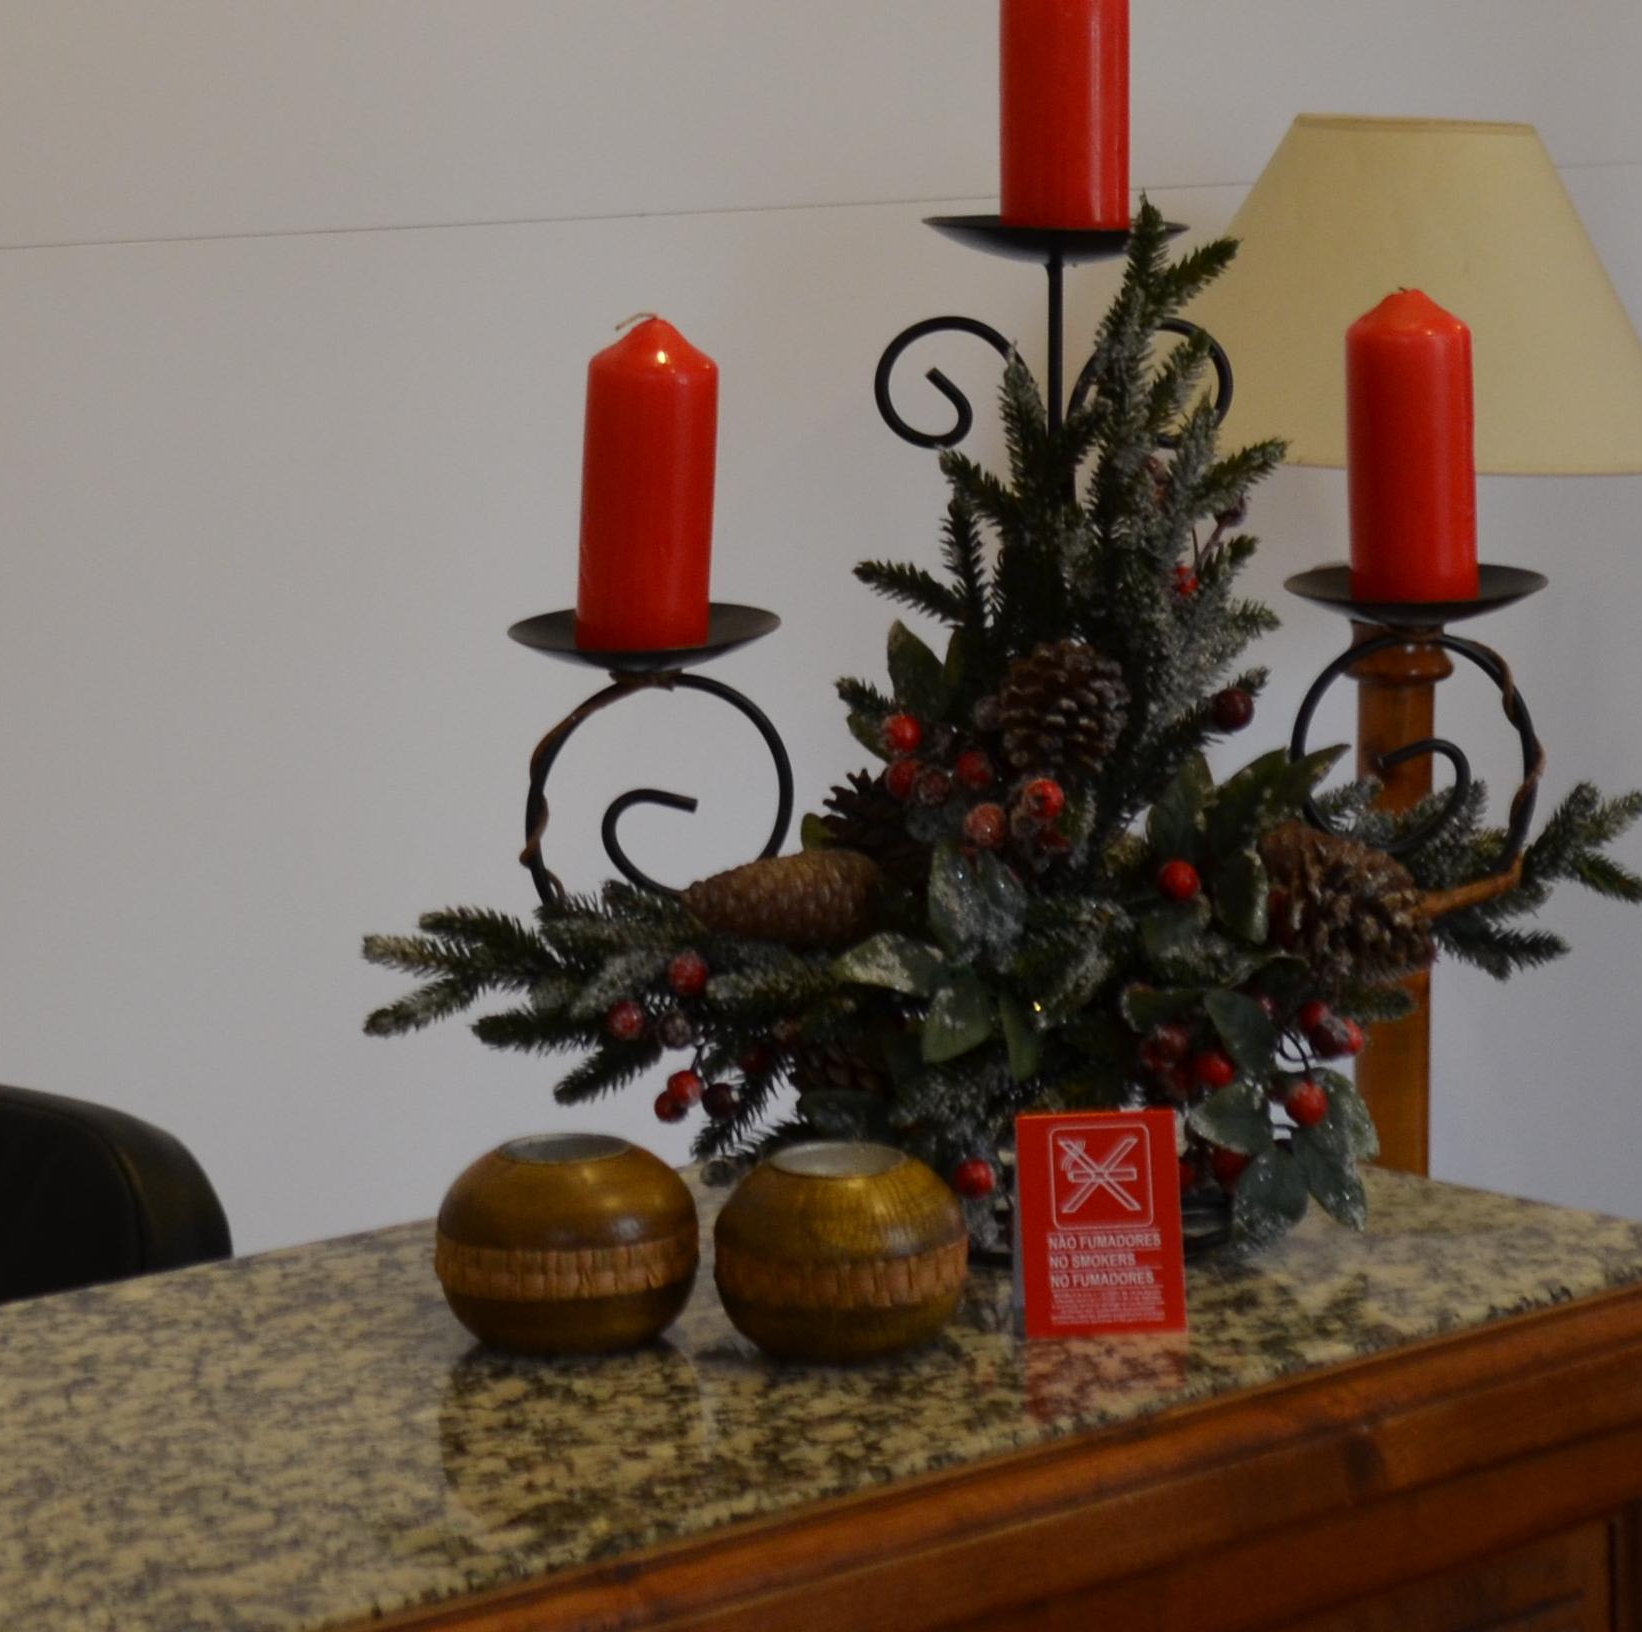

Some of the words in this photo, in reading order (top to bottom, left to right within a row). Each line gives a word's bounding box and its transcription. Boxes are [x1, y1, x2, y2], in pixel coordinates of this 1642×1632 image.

[1079, 1233, 1161, 1249] FUMADORES
[1049, 1256, 1069, 1269] NO
[1071, 1253, 1136, 1269] SMOKERS
[1050, 1275, 1070, 1288] NO
[1072, 1271, 1154, 1287] FUMADORES
